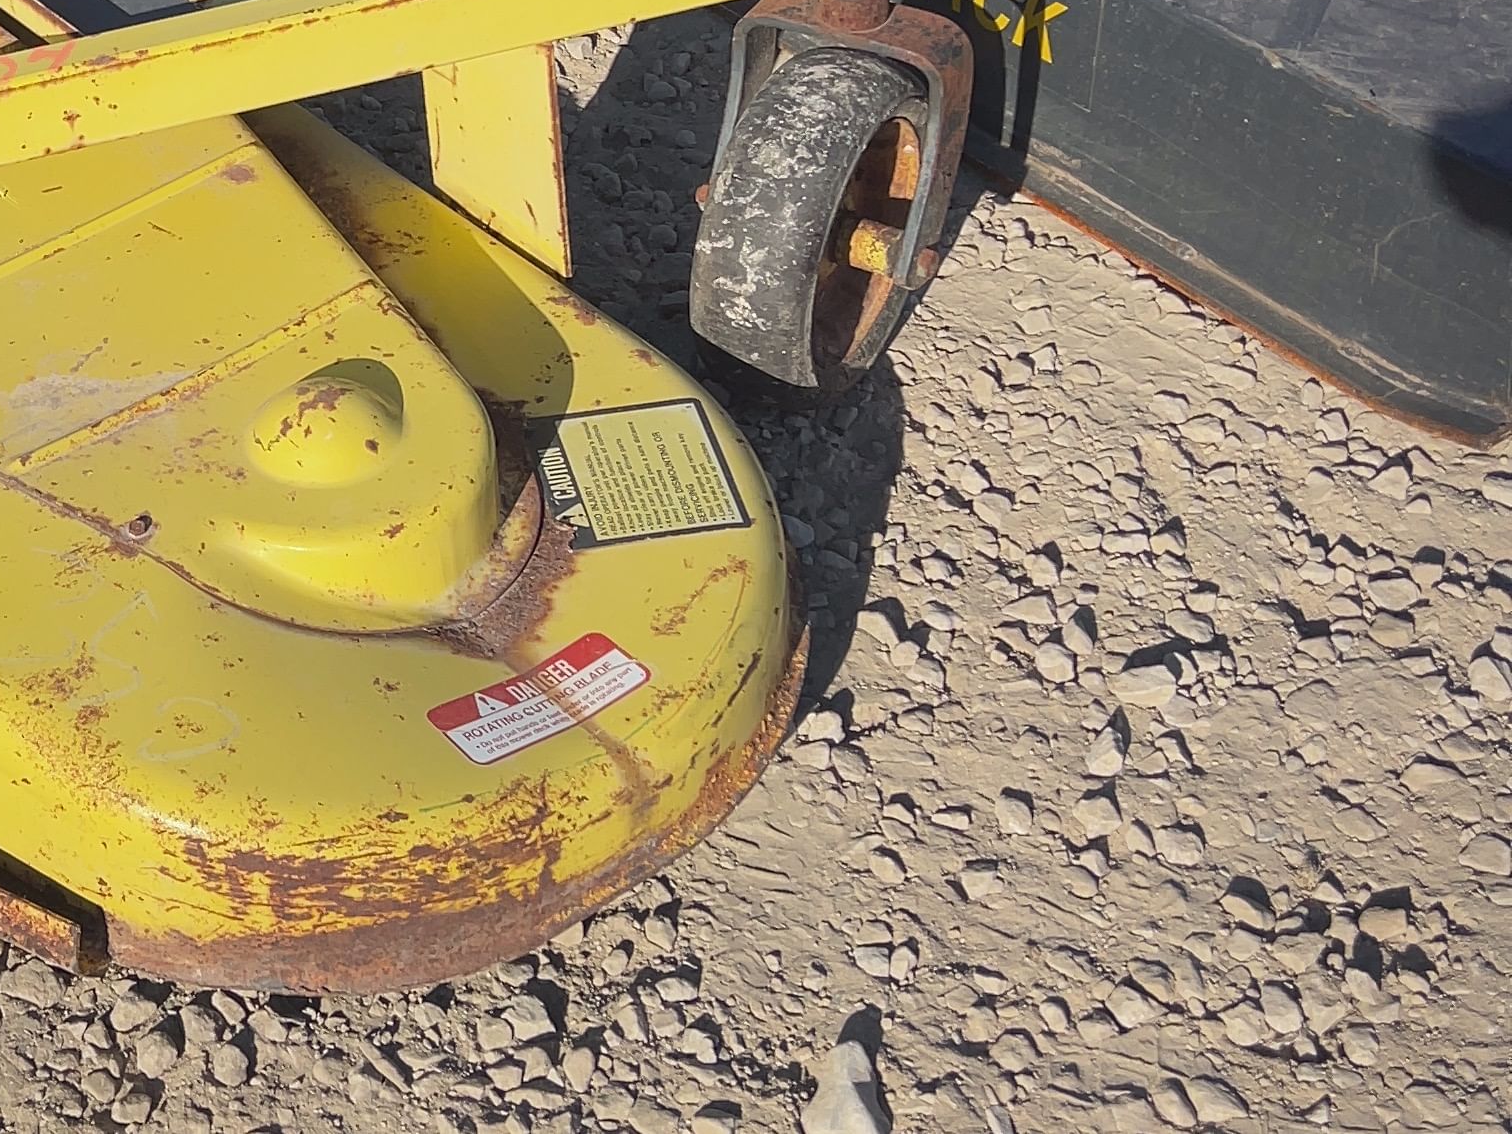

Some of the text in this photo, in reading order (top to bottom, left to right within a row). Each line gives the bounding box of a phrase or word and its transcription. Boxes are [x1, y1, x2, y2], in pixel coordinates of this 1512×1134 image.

[539, 445, 577, 501] CAUTION
[651, 431, 695, 524] BEFORE DISMOUNTING OR
[583, 485, 609, 536] AVOID INJURY
[685, 483, 708, 522] SERVICING
[462, 660, 613, 742] ROTATING CUTTING BLADE
[505, 658, 578, 703] DANGER
